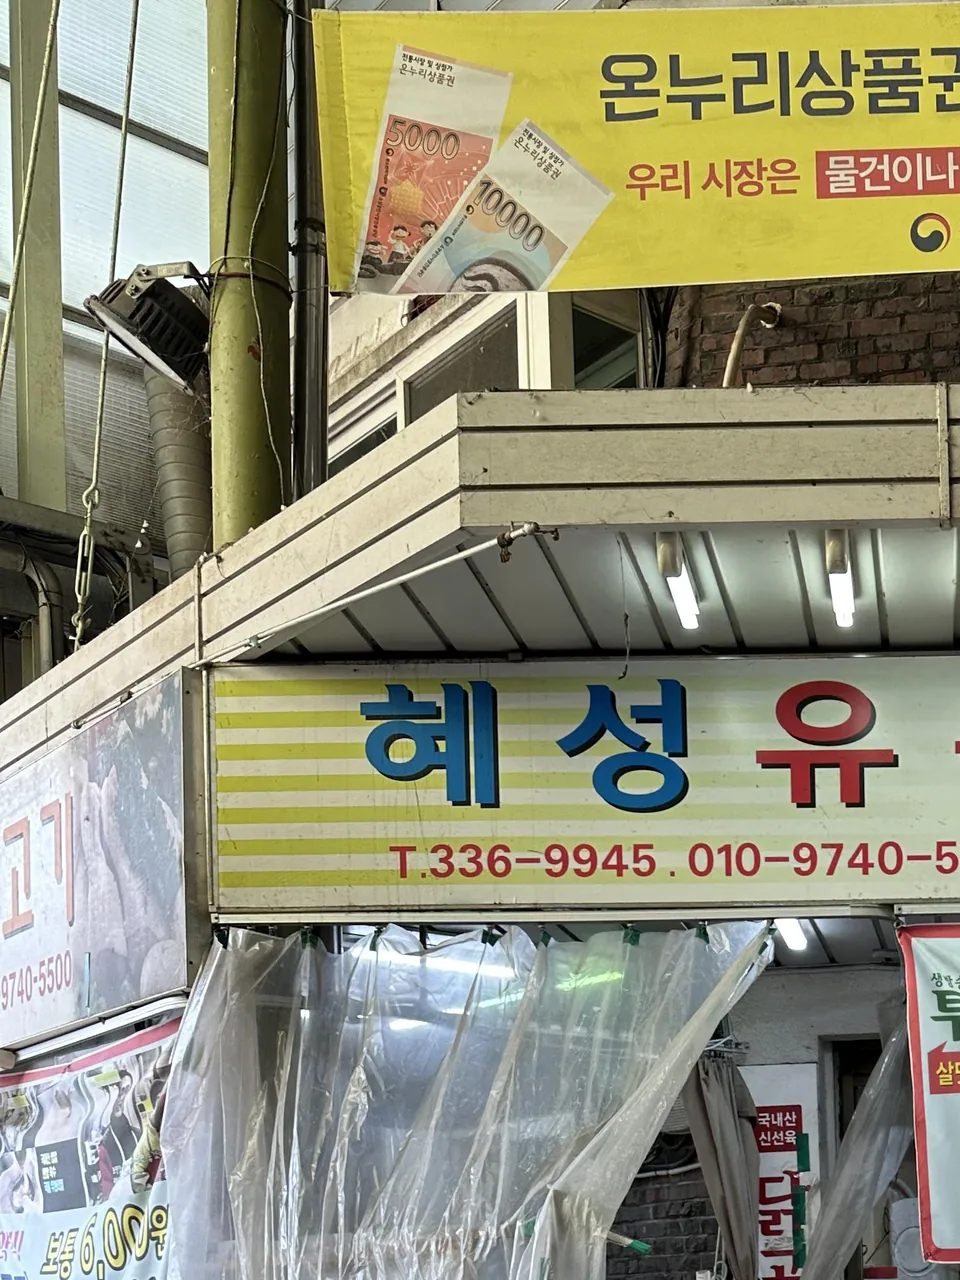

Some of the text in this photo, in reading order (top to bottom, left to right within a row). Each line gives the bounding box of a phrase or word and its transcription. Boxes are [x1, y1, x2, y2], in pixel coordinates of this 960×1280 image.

[399, 63, 456, 87] 온누리상품권
[386, 118, 460, 160] 5000
[514, 136, 562, 180] 온누리상품권
[625, 163, 689, 201] 우리
[702, 158, 800, 195] 시장은
[473, 179, 545, 252] 10000
[758, 1112, 798, 1146] 국내산 신선육
